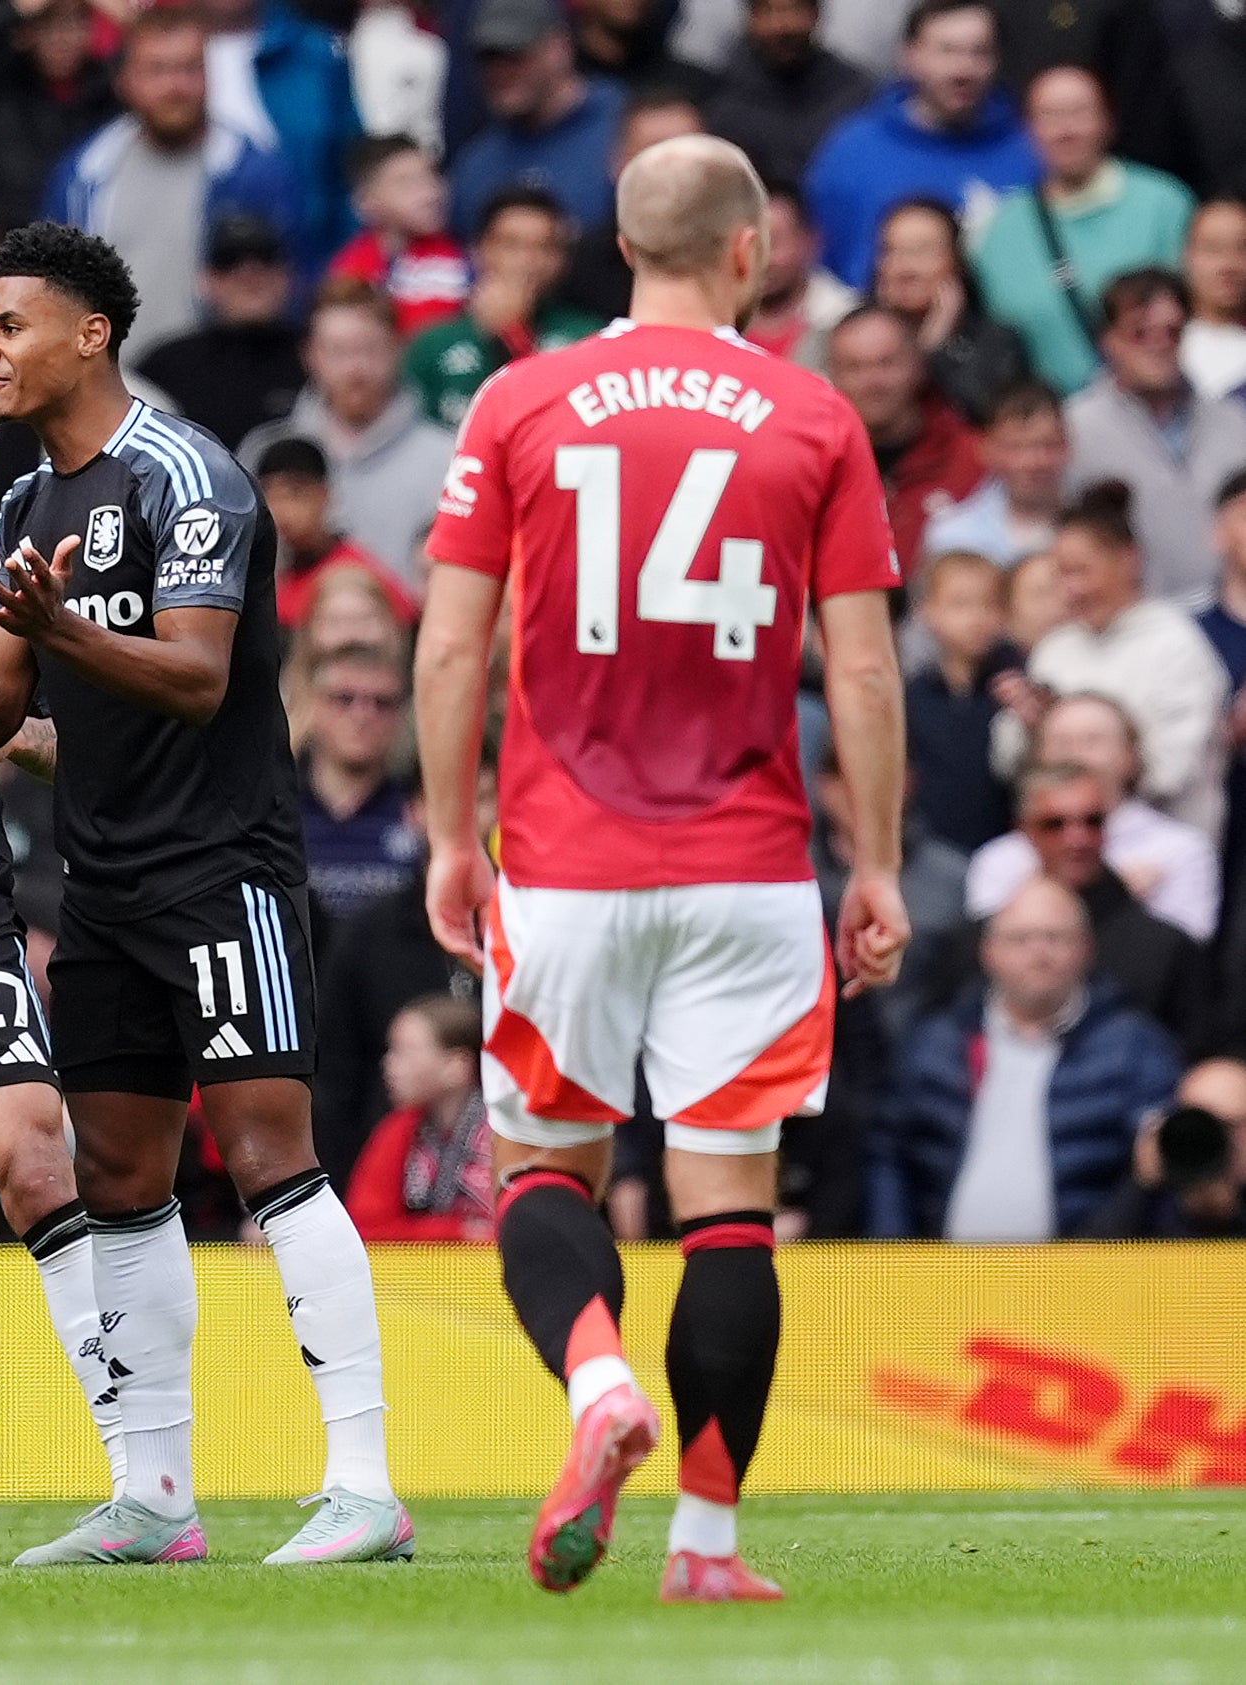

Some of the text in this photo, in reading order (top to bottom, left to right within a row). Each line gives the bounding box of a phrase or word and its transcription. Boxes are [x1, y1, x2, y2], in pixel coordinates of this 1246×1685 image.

[567, 366, 775, 434] ERIKSEN
[161, 559, 224, 575] TRADE
[554, 443, 777, 662] 14
[157, 572, 222, 589] NATION
[64, 591, 144, 630] no
[189, 940, 248, 1018] 11
